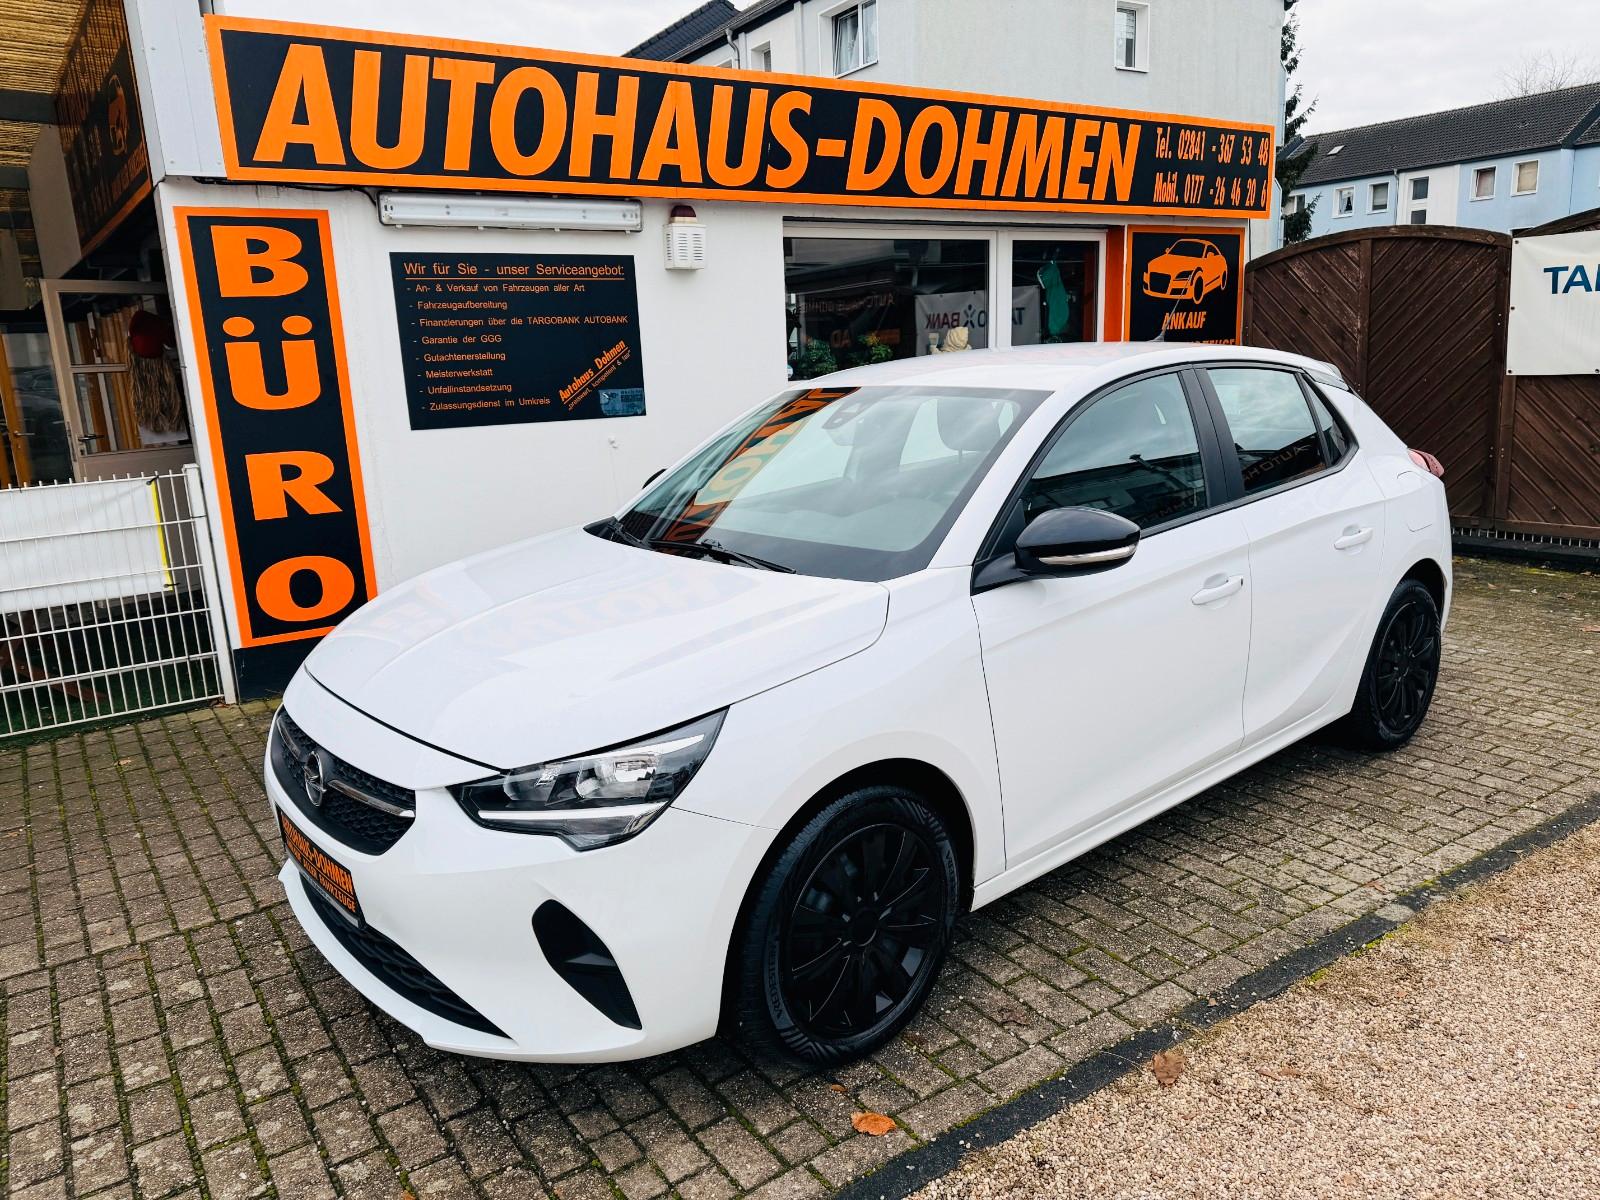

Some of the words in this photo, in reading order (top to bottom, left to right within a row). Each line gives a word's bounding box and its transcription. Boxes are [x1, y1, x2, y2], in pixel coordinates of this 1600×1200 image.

[253, 43, 1141, 202] AUTOHAUS-DOHMEN
[1155, 126, 1172, 159] Tel.
[1177, 128, 1206, 161] 02841
[1217, 133, 1235, 164] 367
[1240, 135, 1253, 166] 53
[1258, 137, 1269, 166] 48
[1153, 171, 1179, 204] Mobil.
[1184, 173, 1205, 204] 0177
[1230, 177, 1241, 207] 46
[1245, 178, 1256, 207] 20
[403, 262, 427, 275] Wir
[432, 262, 450, 275] für
[457, 262, 478, 275] Sie
[496, 264, 530, 275] unser
[536, 263, 625, 278] Serviceangebot:
[415, 283, 431, 293] An-
[435, 283, 443, 292] &
[446, 283, 479, 293] Verkauf
[502, 283, 549, 294] Fahrzeugen
[553, 283, 570, 292] aller
[573, 283, 585, 292] Art
[417, 300, 508, 311] Fahrzeugaufbereitung
[419, 318, 484, 328] Finanzierungen
[488, 317, 506, 326] über
[510, 316, 523, 326] die
[527, 316, 580, 326] TARGOBANK
[583, 315, 629, 324] AUTOBANK
[421, 335, 458, 345] Garantie
[462, 334, 476, 344] der
[480, 334, 502, 343] GGG
[423, 352, 506, 362] Gutachtenerstellung
[425, 368, 493, 379] Meisterwerkstatt
[558, 368, 594, 401] Autohaus
[594, 340, 626, 369] Dohmen
[427, 384, 513, 395] Unfallinstandsetzung
[429, 399, 501, 411] Zulassungsdienst
[504, 397, 515, 407] im
[518, 397, 551, 406] Umkreis
[210, 225, 356, 622] BÜRO
